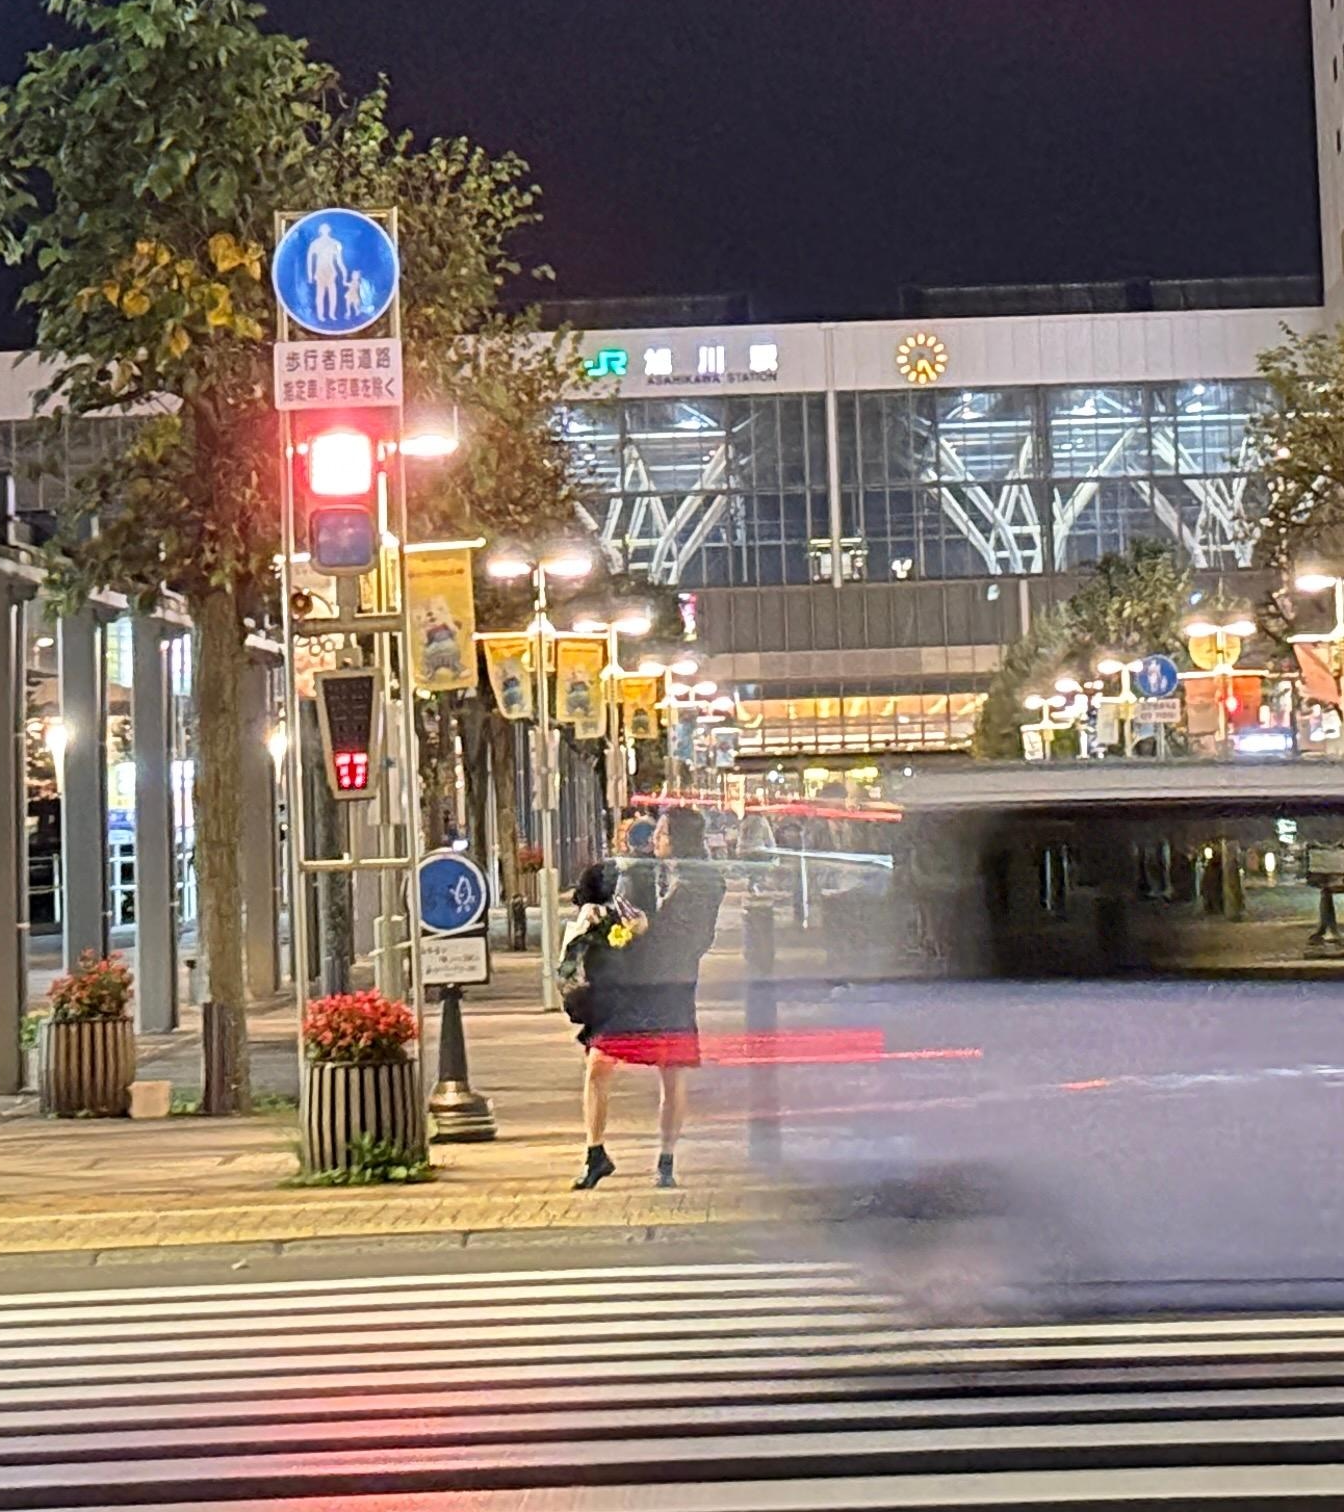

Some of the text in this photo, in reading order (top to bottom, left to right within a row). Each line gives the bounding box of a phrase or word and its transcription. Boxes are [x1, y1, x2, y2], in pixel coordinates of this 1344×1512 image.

[285, 346, 391, 373] 歩行者用道路
[583, 349, 628, 377] JR
[647, 371, 778, 386] ASAHIKAWA STATION
